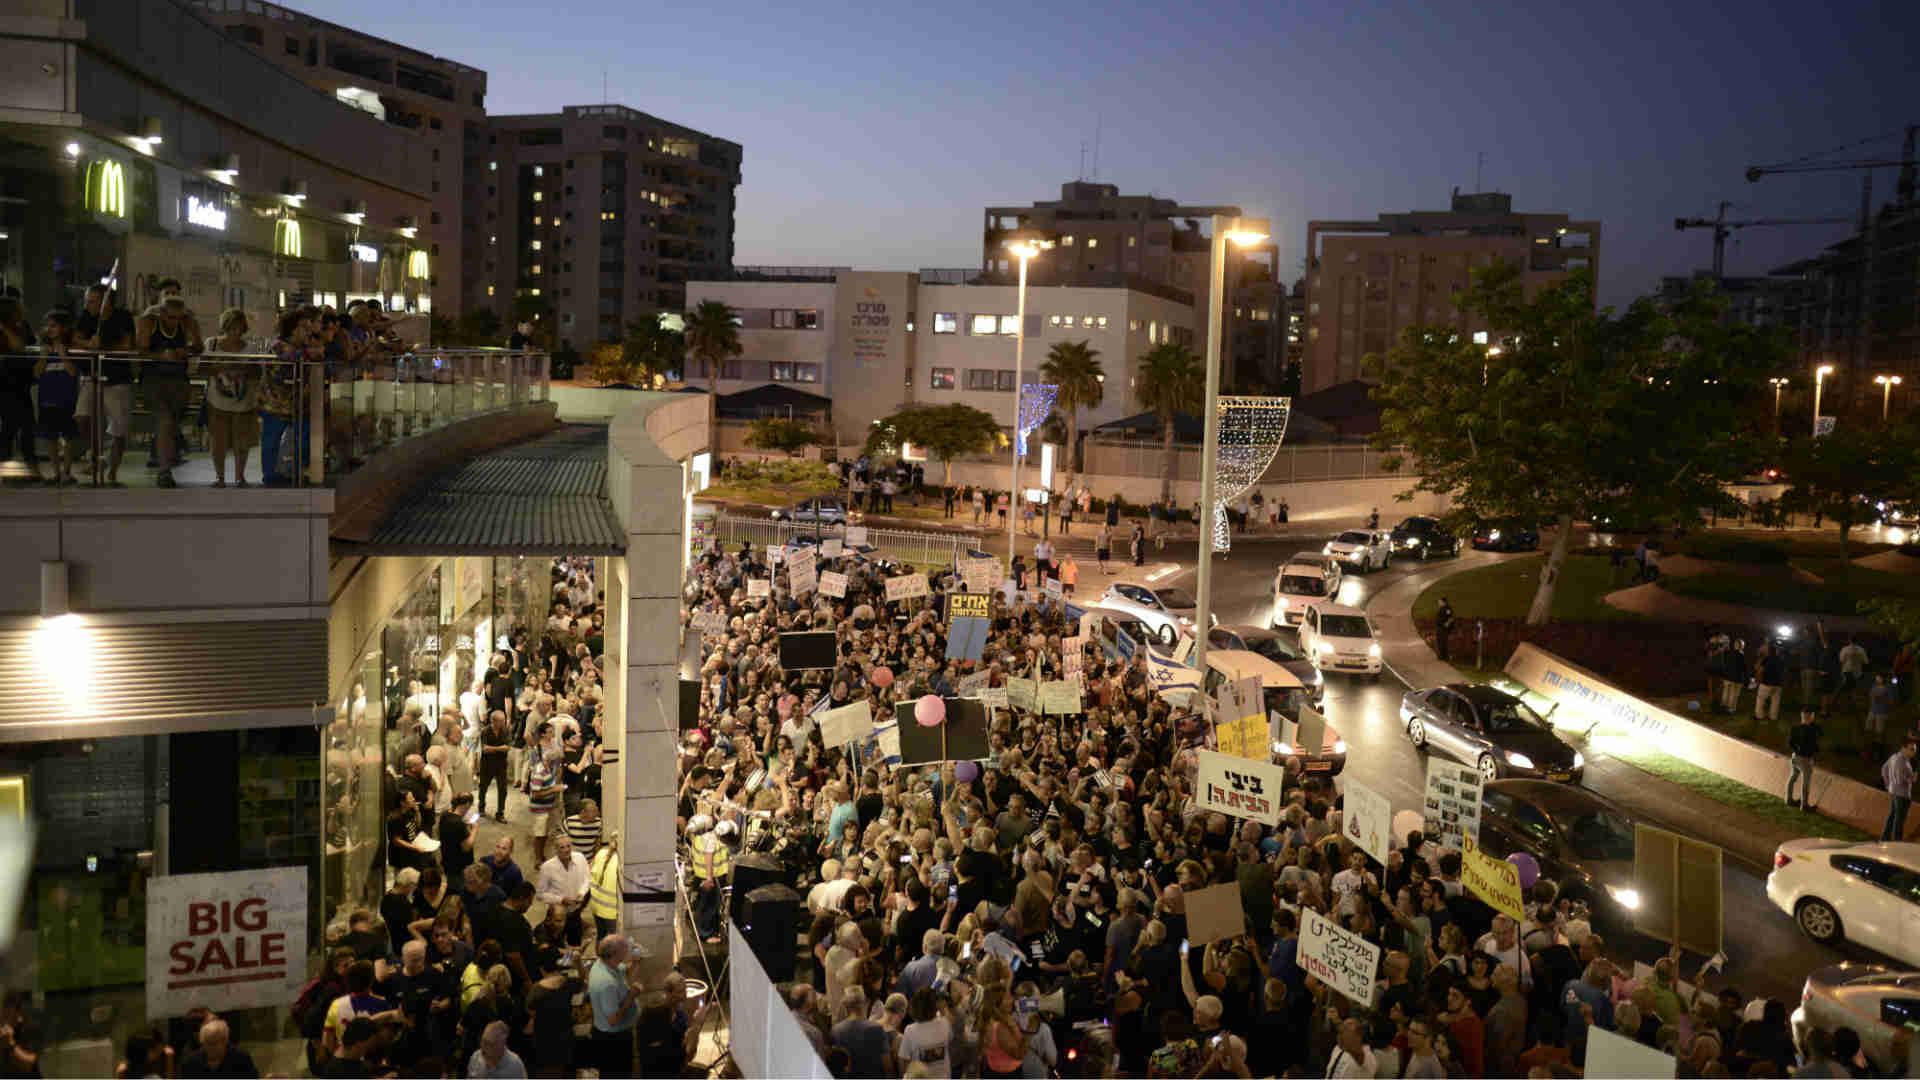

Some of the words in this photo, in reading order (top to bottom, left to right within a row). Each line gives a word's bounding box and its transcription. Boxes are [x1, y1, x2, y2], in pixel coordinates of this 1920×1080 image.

[951, 595, 990, 609] אחים
[1224, 769, 1264, 795] ביבי
[1207, 783, 1270, 815] הביתה!
[188, 897, 269, 937] BIG
[168, 933, 287, 976] SALE
